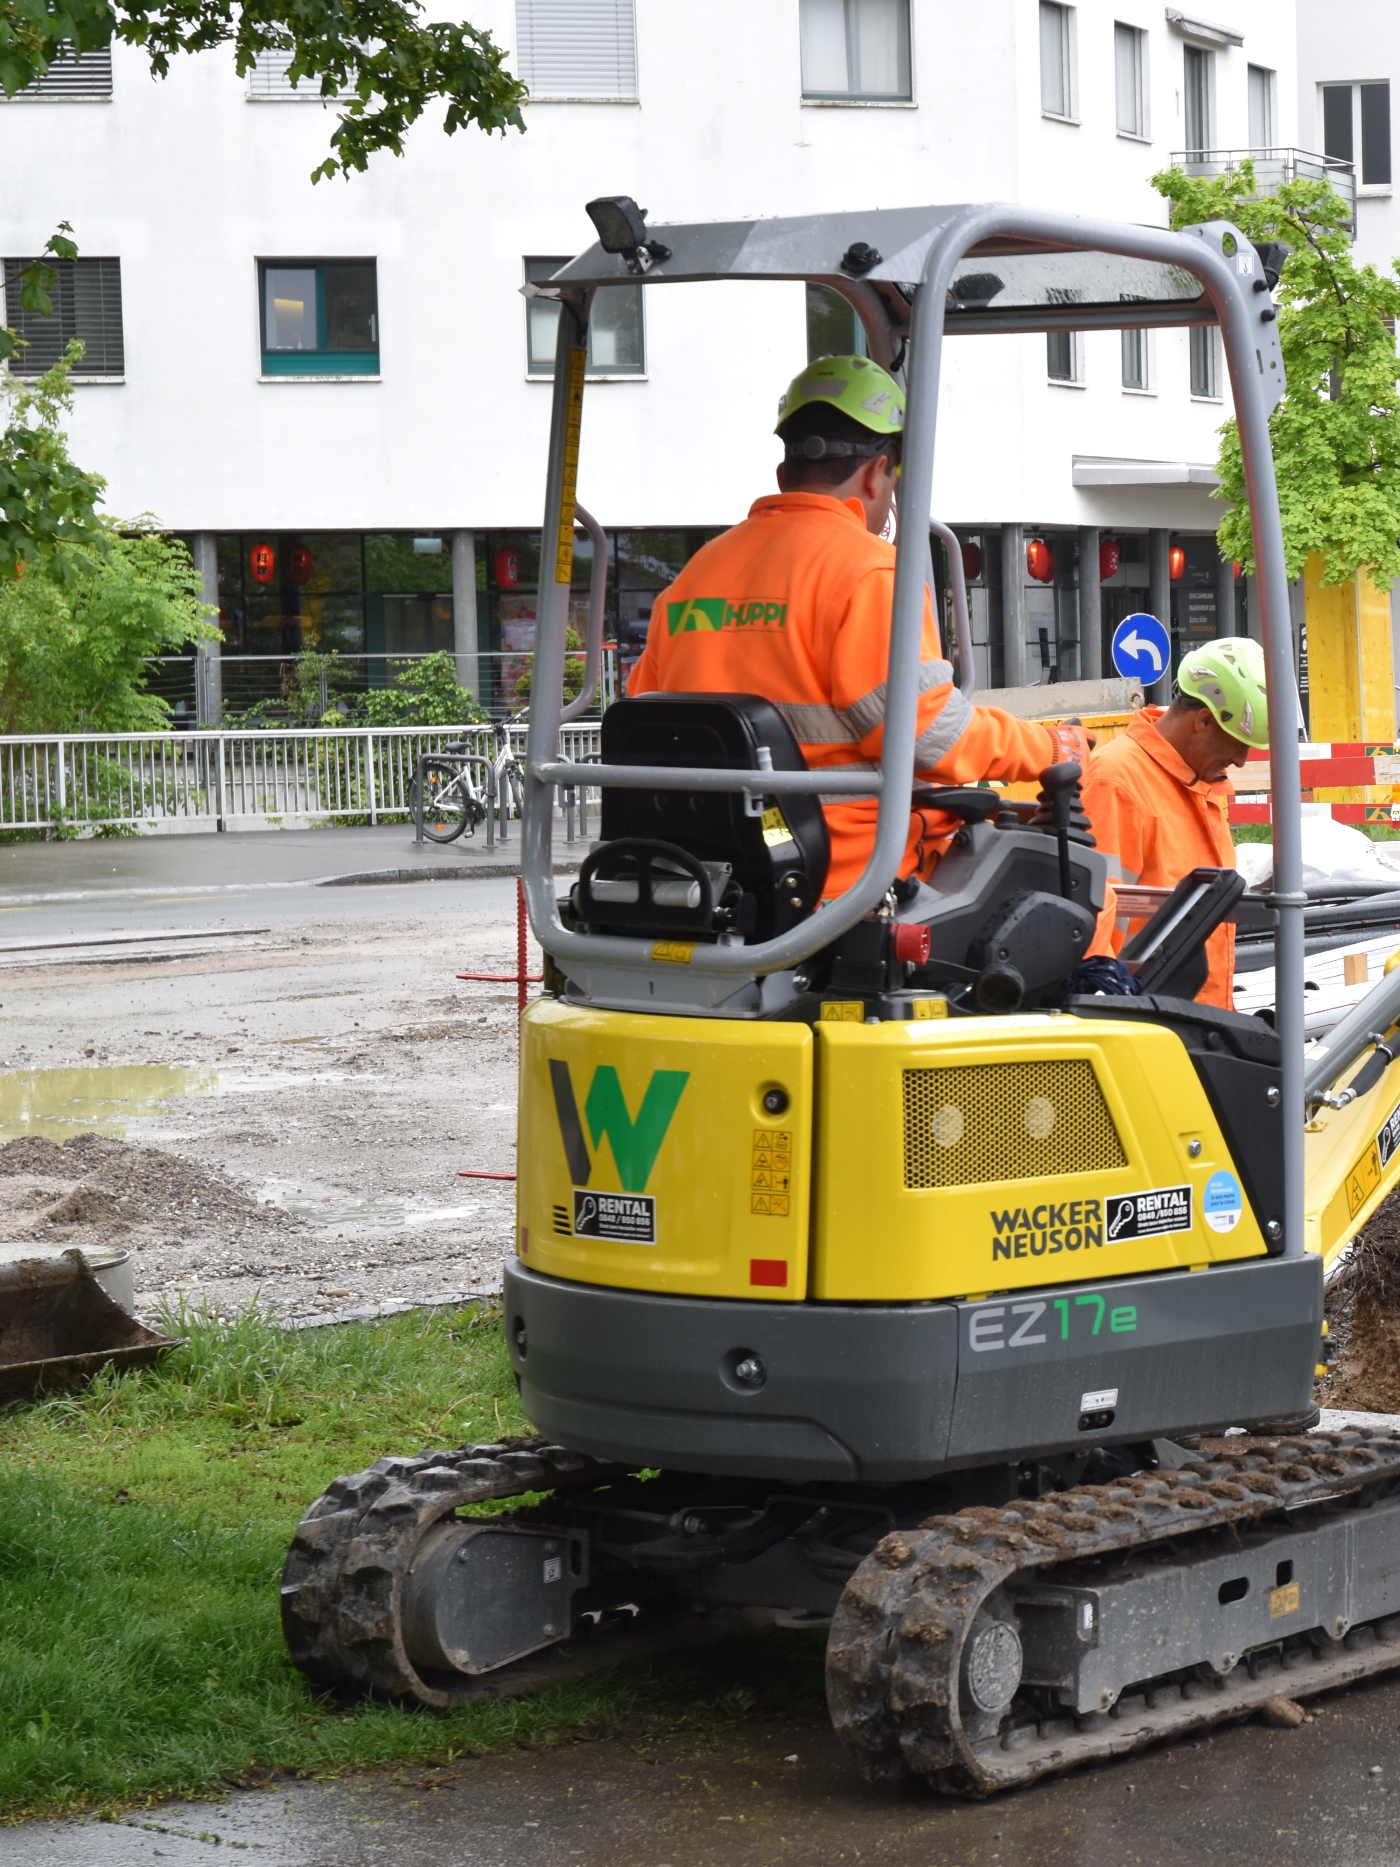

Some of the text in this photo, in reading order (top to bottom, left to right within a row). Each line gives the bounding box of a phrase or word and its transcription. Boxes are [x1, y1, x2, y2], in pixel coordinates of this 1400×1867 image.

[598, 1198, 650, 1217] RENTAL
[990, 1199, 1103, 1235] WACKER
[1137, 1192, 1188, 1212] RENTAL
[992, 1223, 1103, 1261] NEUSON
[969, 1293, 1137, 1352] EZ17e
